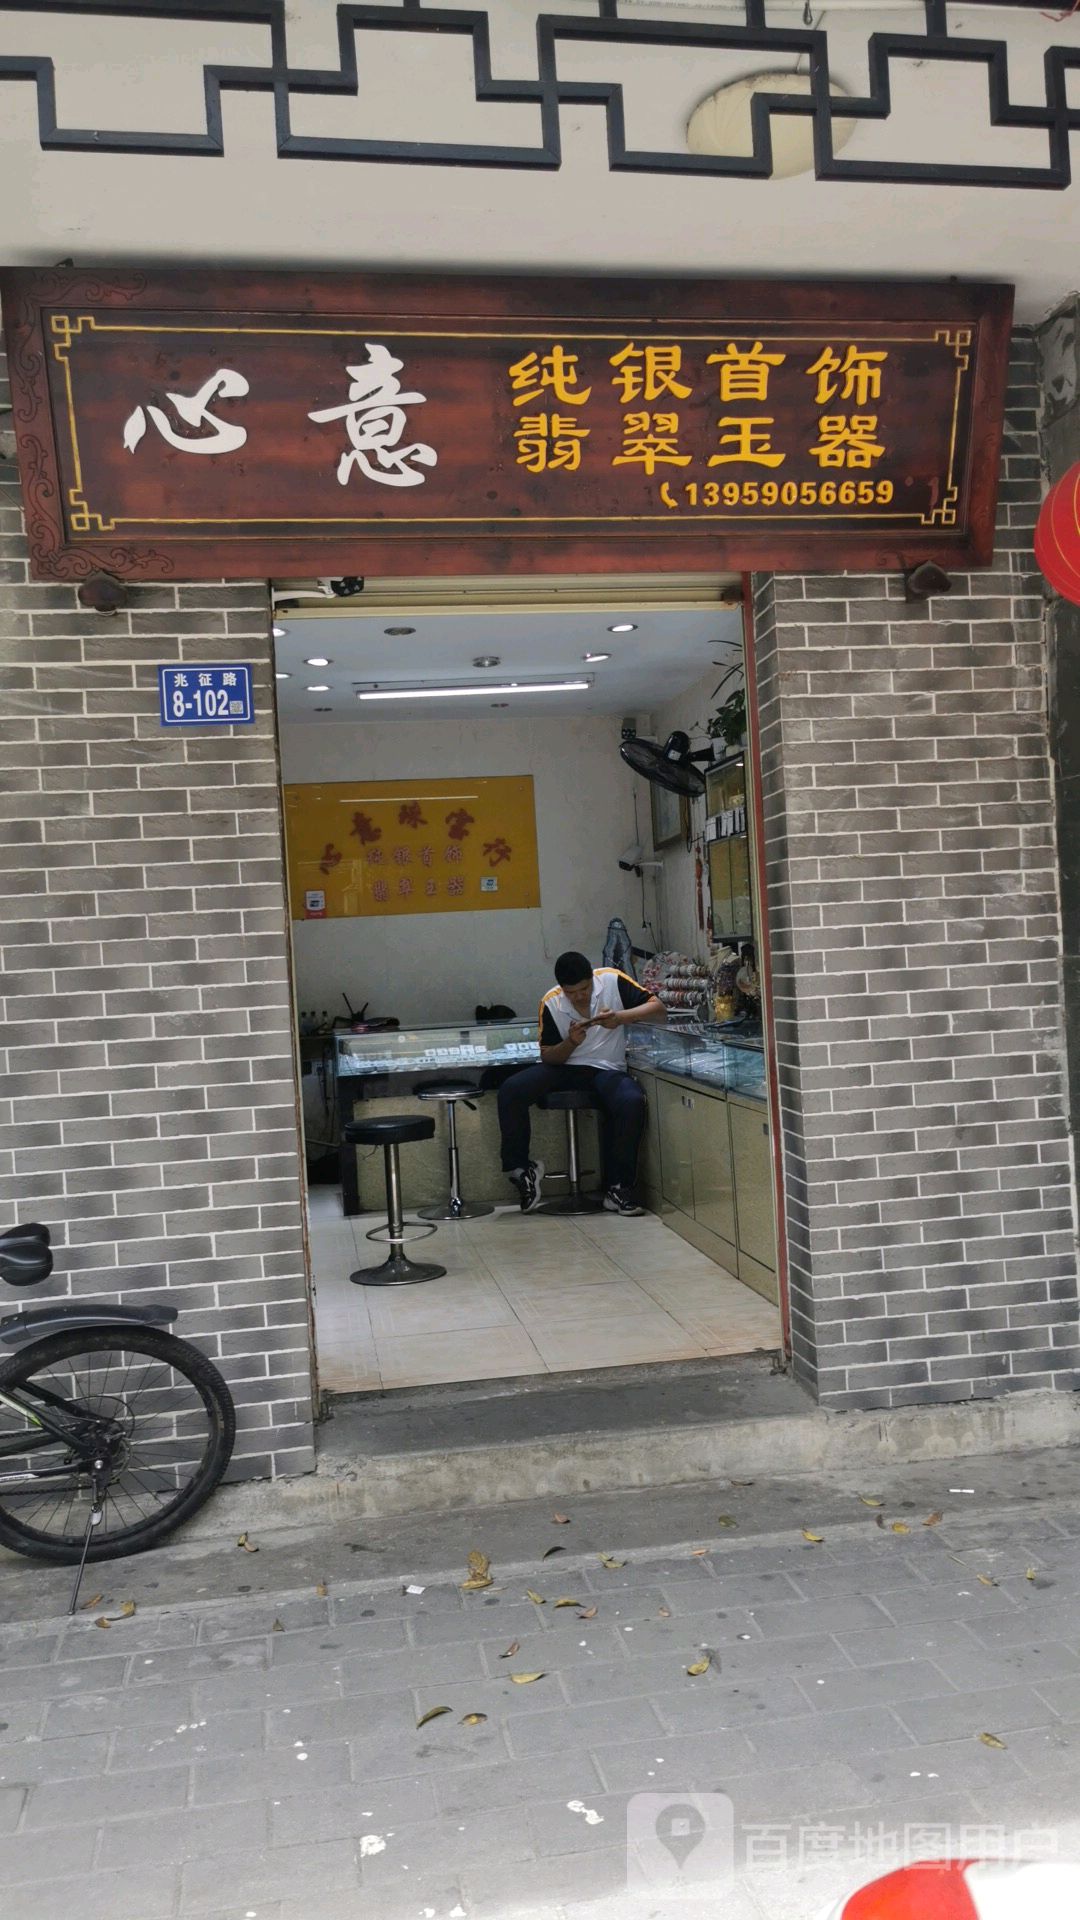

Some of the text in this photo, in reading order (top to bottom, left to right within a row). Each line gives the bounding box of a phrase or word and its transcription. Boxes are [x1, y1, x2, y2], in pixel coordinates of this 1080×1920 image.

[508, 342, 888, 406] 纯银首饰
[123, 343, 438, 487] 心意
[513, 411, 886, 475] 翡翠玉器
[684, 480, 894, 507] 13959056659
[174, 672, 237, 687] 兆征路
[173, 689, 229, 717] 8-102
